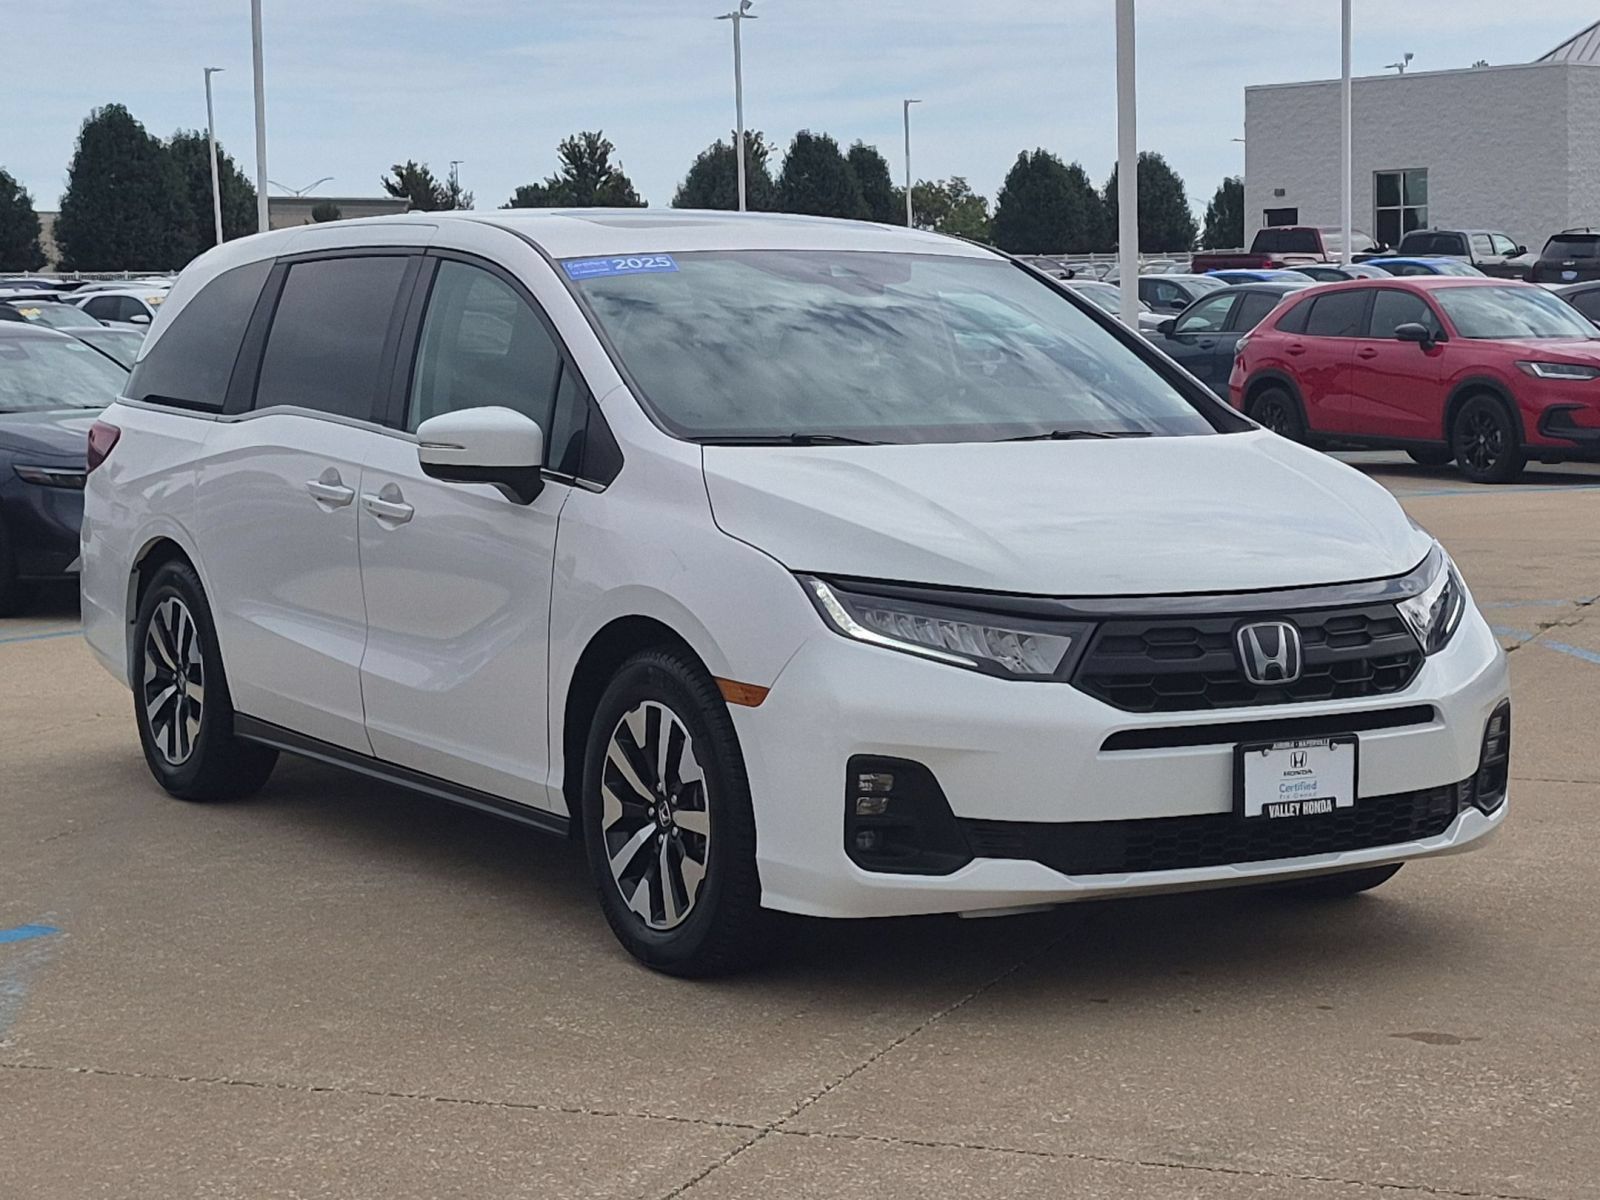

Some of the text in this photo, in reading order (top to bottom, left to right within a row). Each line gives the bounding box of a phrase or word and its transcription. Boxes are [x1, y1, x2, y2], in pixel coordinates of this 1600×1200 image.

[612, 257, 671, 270] 2025
[1279, 780, 1317, 793] Certified
[1268, 799, 1333, 818] VALLEY HONDA
